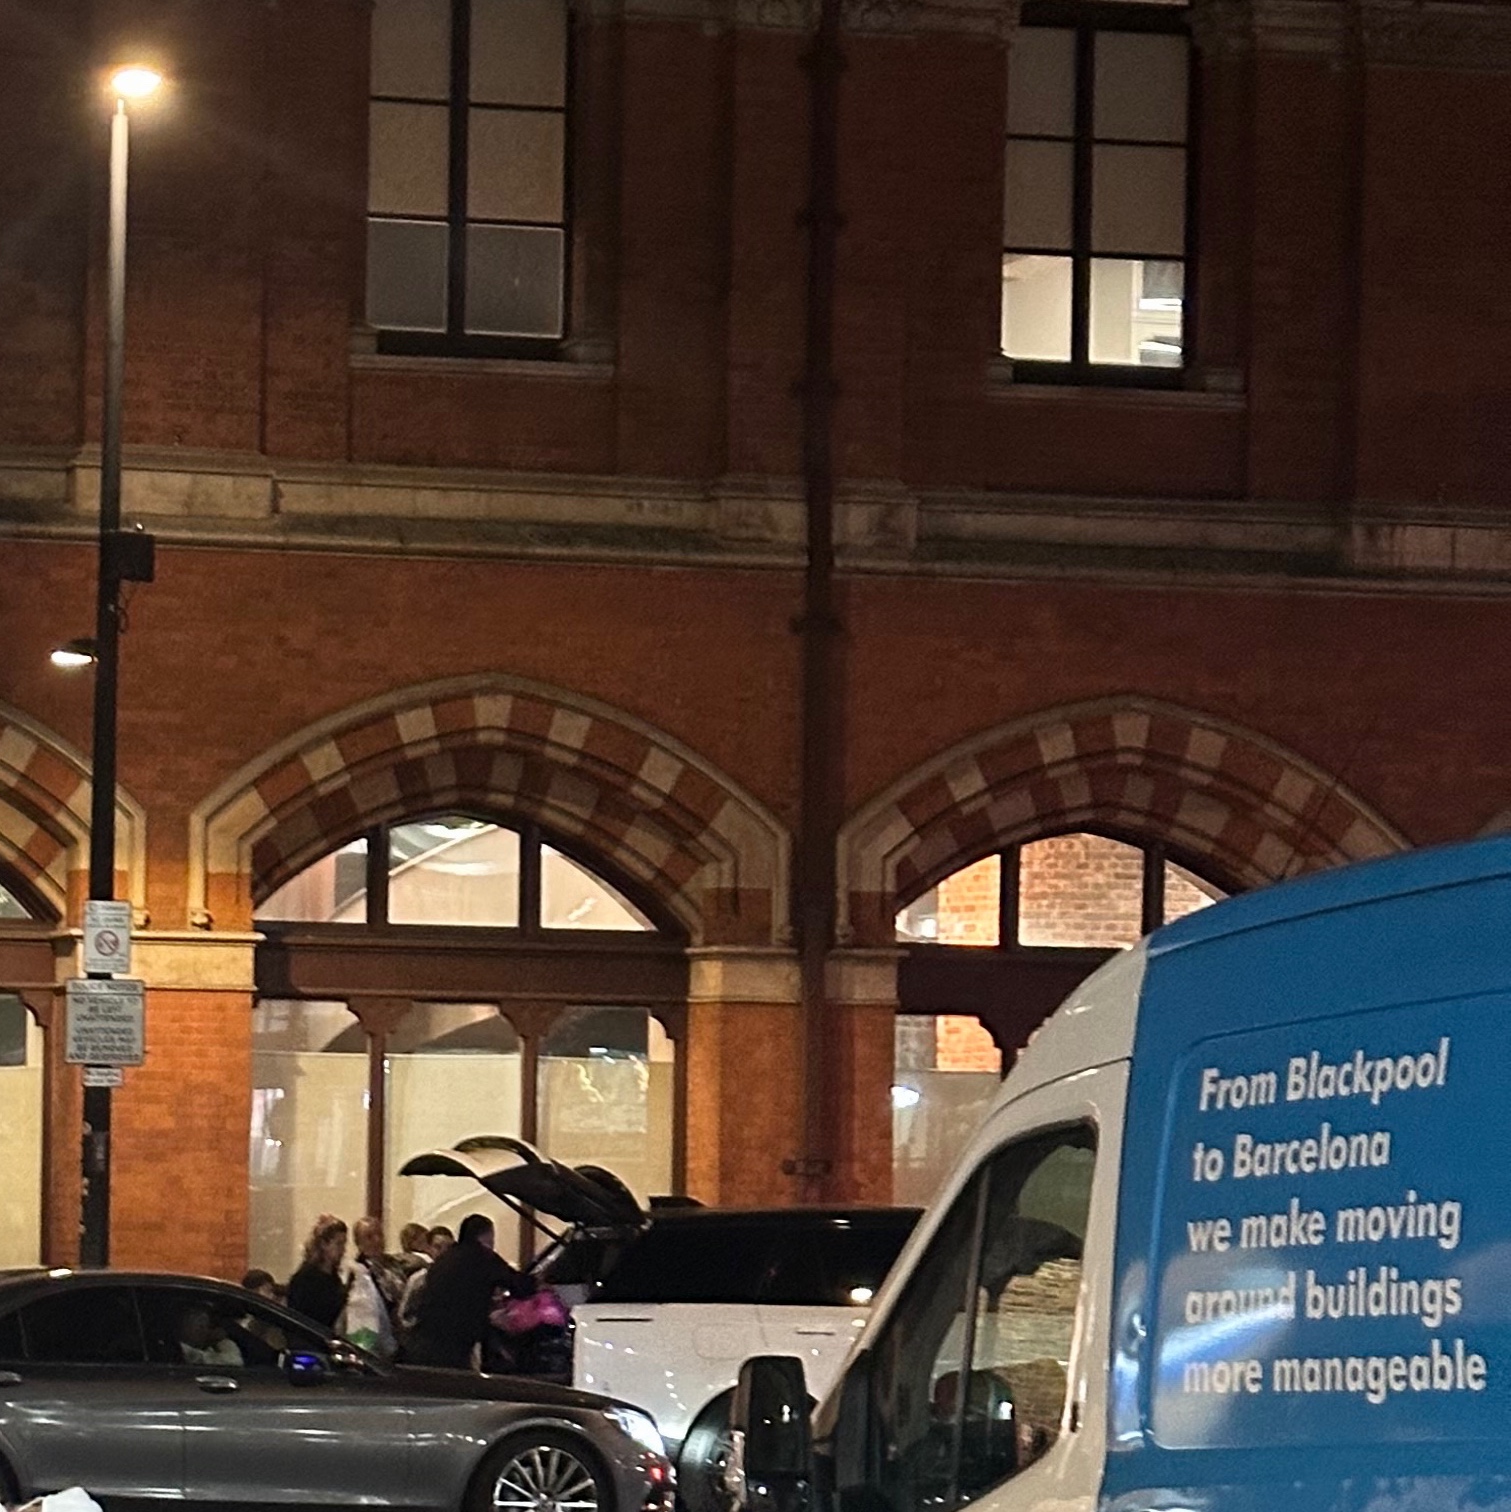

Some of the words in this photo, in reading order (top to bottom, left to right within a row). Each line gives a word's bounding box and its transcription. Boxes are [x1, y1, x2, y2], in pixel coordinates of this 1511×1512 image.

[1199, 1067, 1277, 1111] From
[1286, 1036, 1450, 1105] Blackpool
[1193, 1142, 1224, 1181] to
[1233, 1122, 1391, 1179] Barcelona
[1188, 1216, 1232, 1252] we
[1241, 1197, 1326, 1250] make
[1336, 1190, 1462, 1250] moving
[1186, 1271, 1296, 1325] around
[1306, 1266, 1463, 1328] buildings
[1184, 1359, 1263, 1394] more
[1273, 1338, 1488, 1404] manageable
